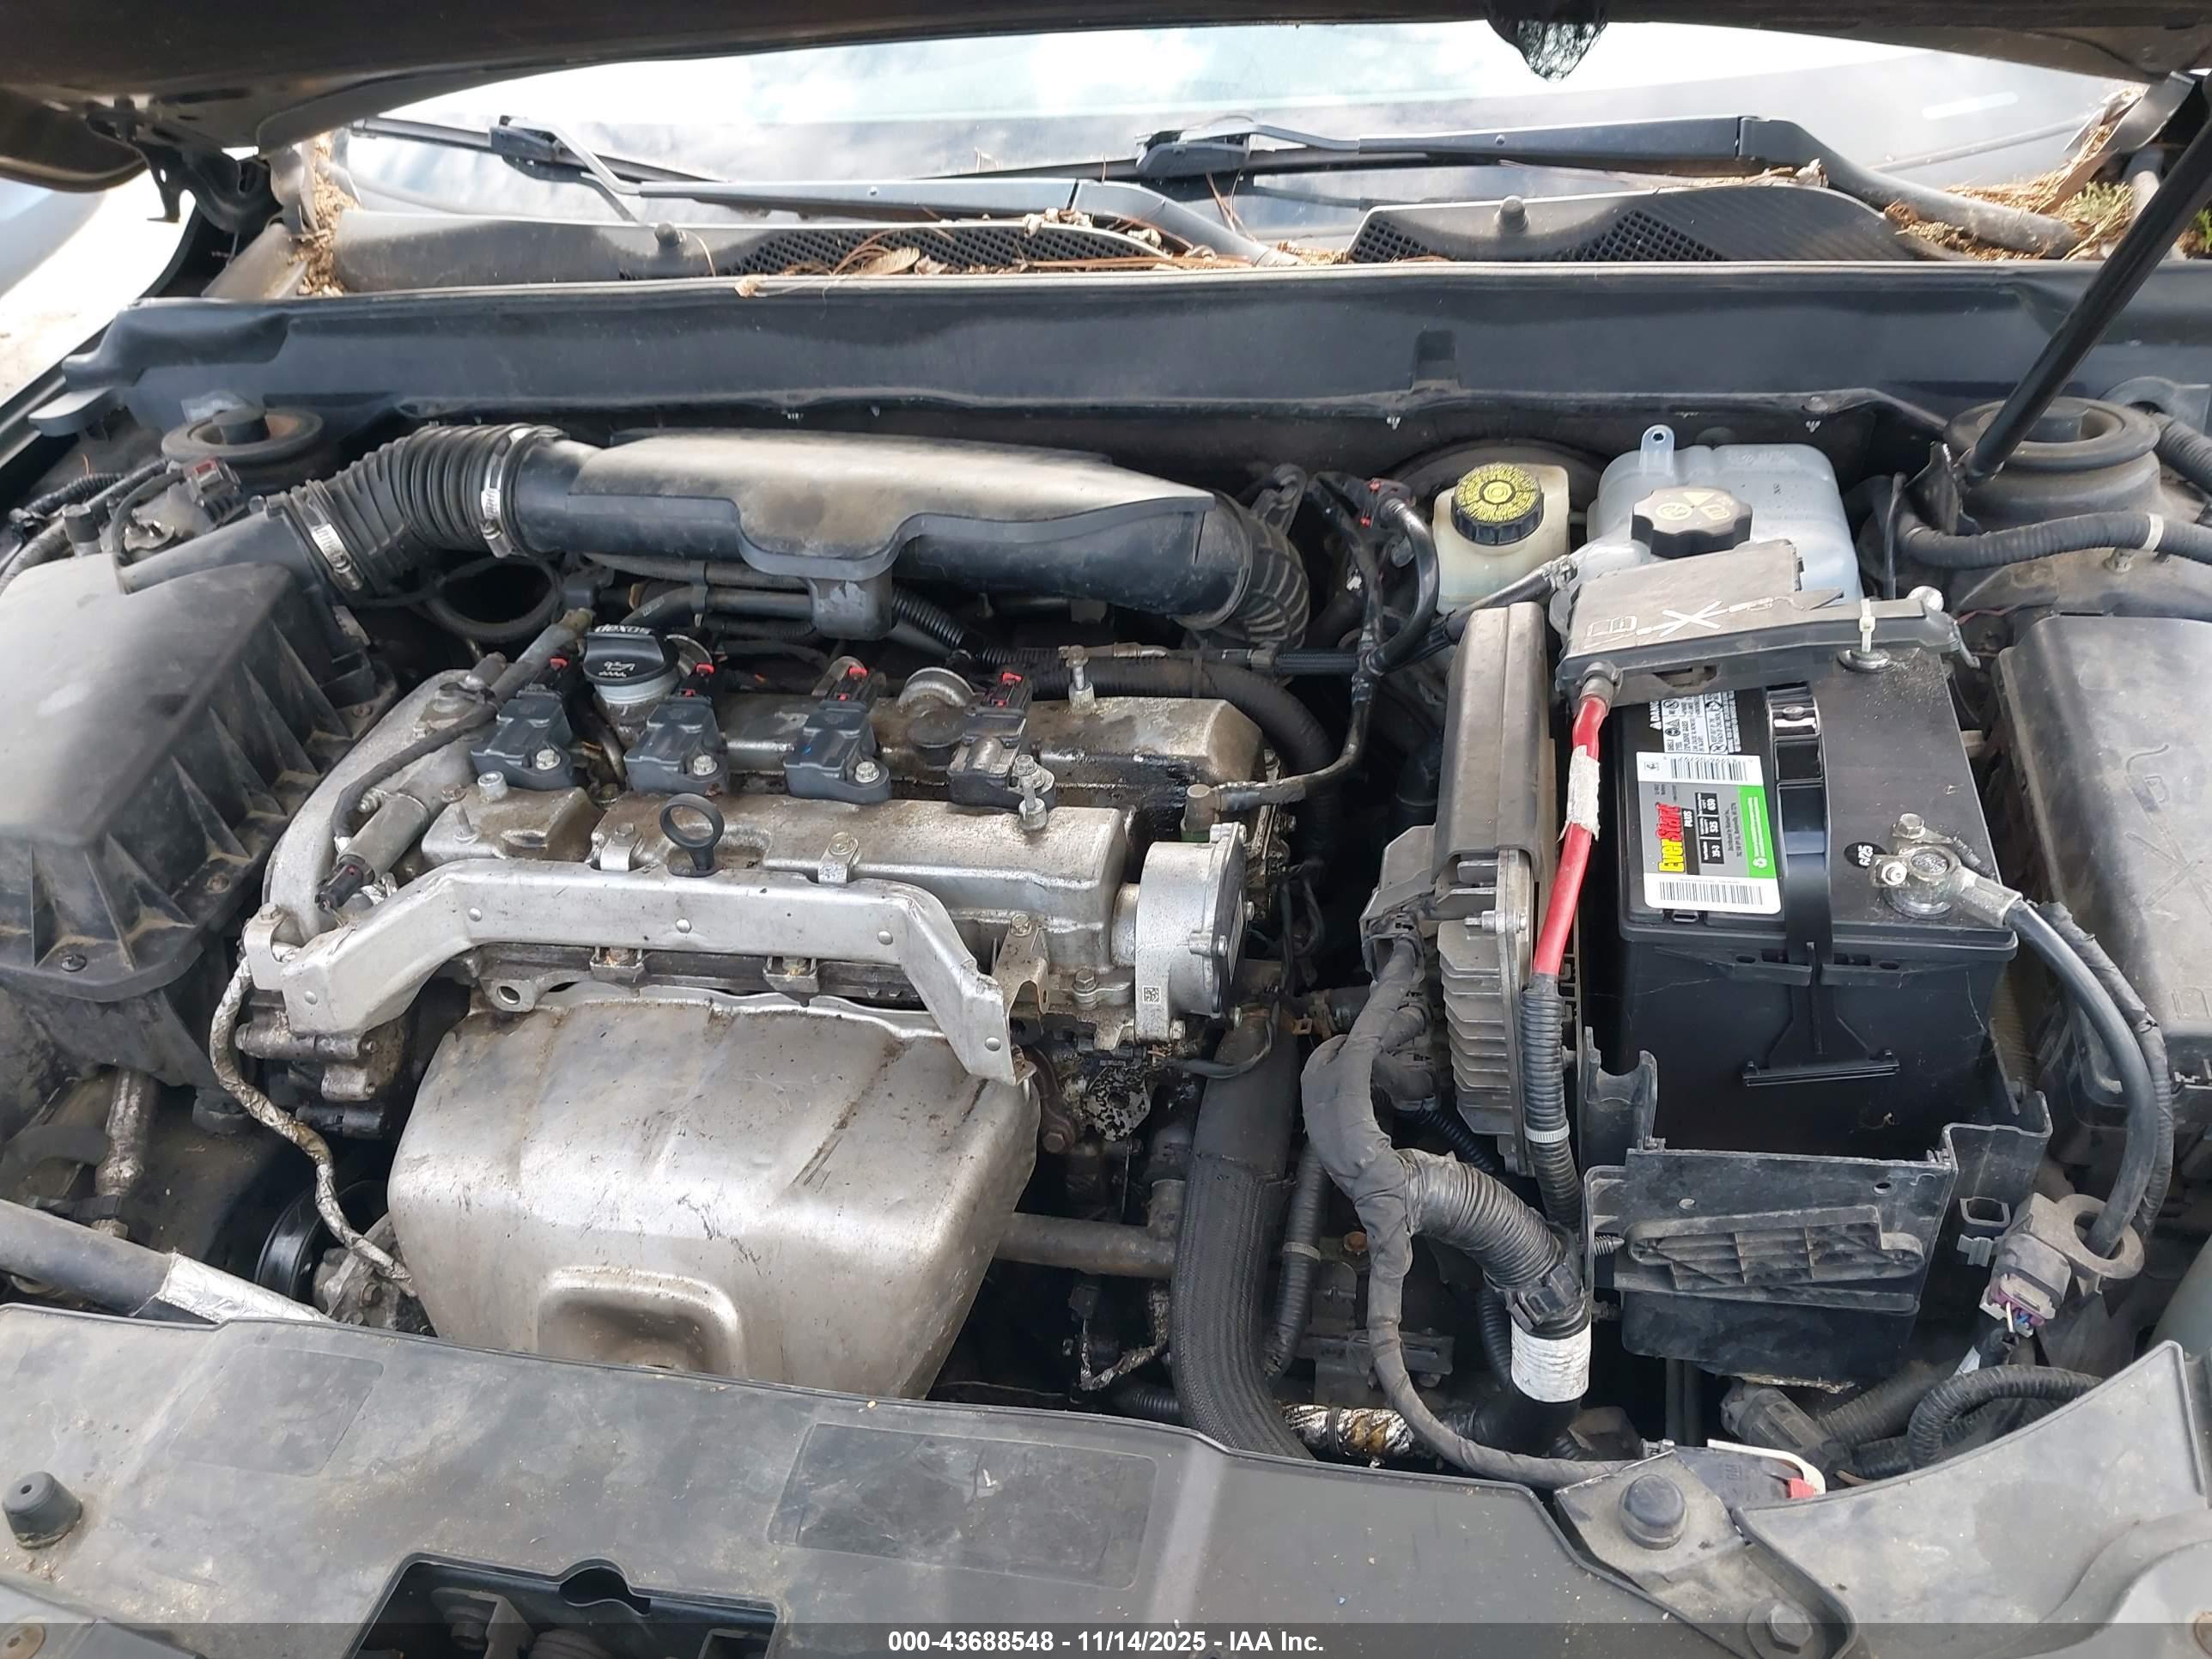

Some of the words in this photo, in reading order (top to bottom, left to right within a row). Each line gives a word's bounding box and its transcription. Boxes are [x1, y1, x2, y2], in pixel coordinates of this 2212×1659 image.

[594, 623, 653, 635] dexos
[1707, 798, 1716, 811] 650
[1683, 811, 1692, 828] PLUS
[1710, 821, 1718, 833] 525
[1656, 802, 1685, 872] EverStart
[1711, 844, 1721, 858] 35-3
